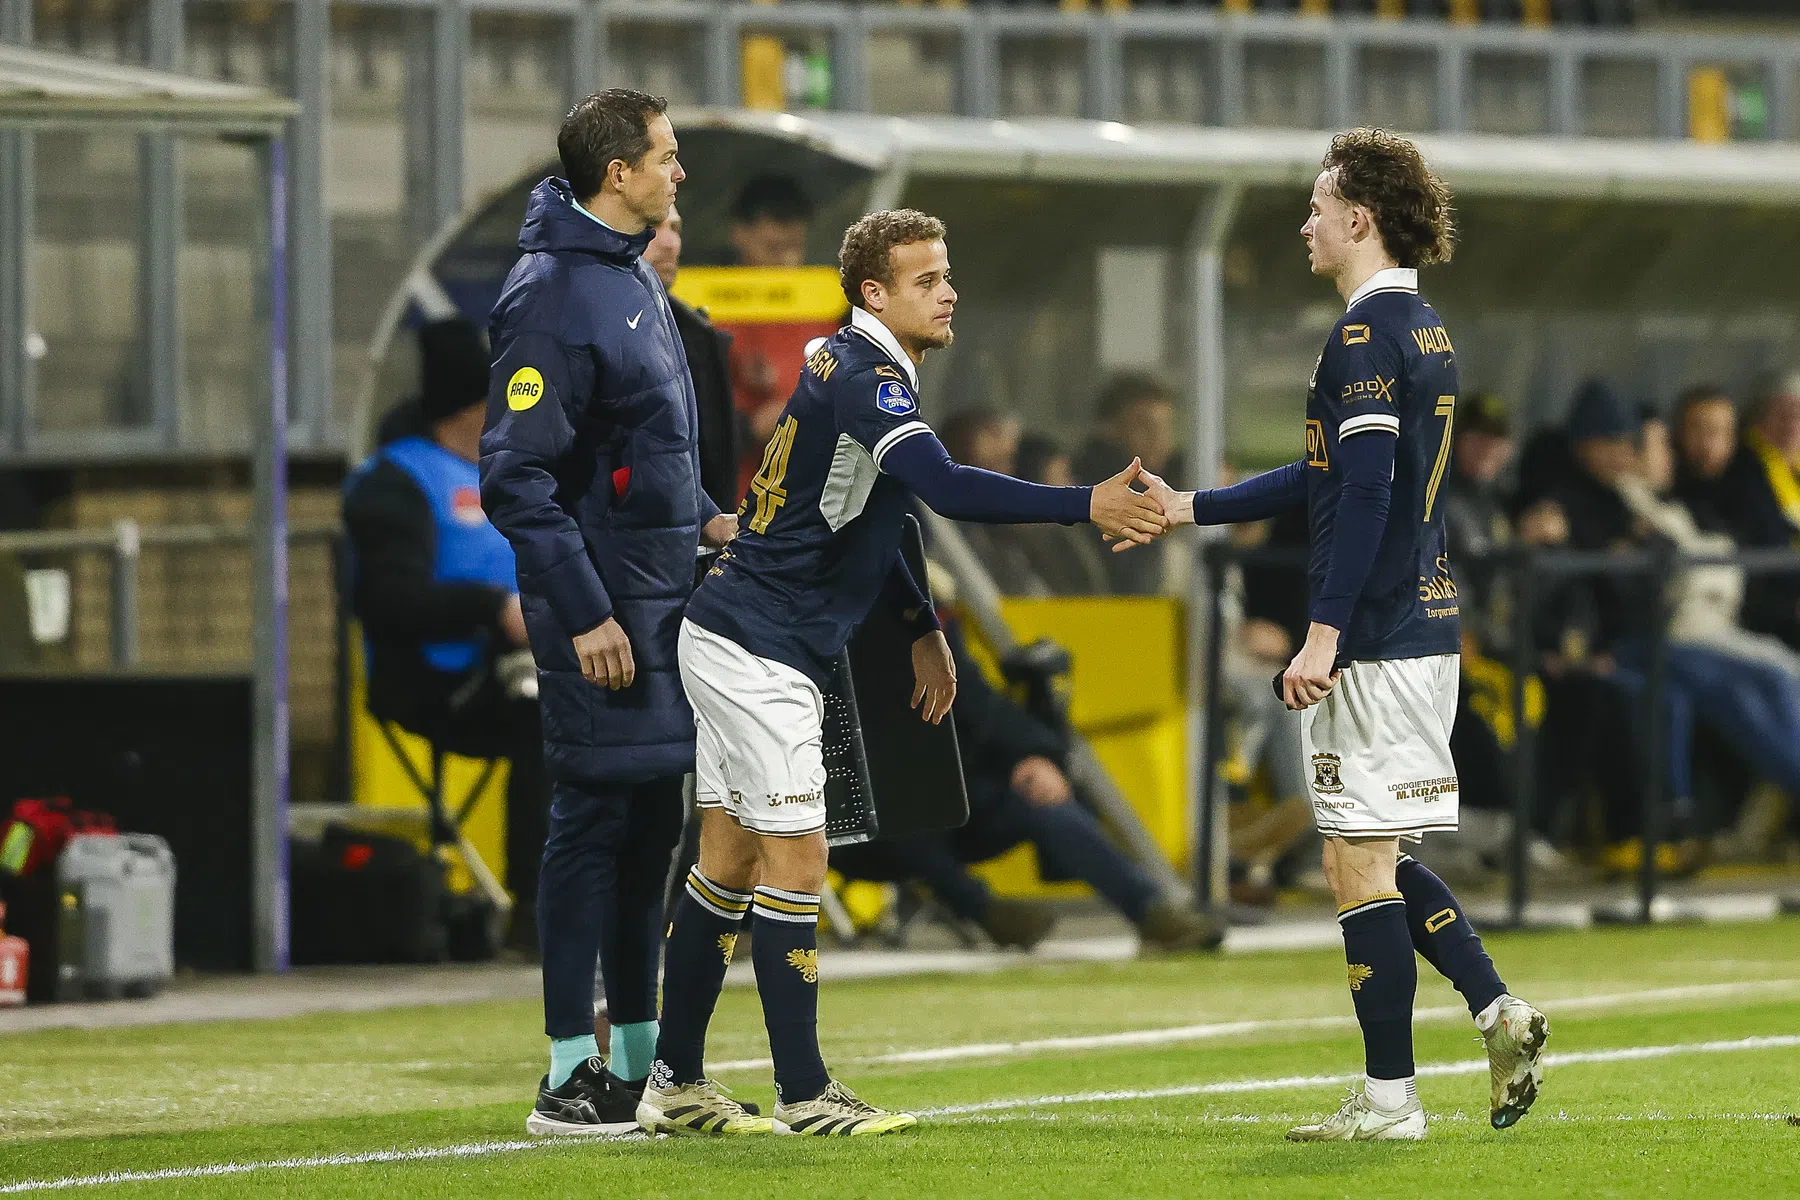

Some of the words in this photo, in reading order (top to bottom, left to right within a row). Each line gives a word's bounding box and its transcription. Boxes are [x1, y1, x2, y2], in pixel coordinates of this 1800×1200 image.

[510, 382, 540, 397] ARAG
[1423, 395, 1456, 522] 7
[784, 788, 815, 804] maxi
[1411, 783, 1458, 799] KRAME
[1424, 795, 1440, 803] EPE
